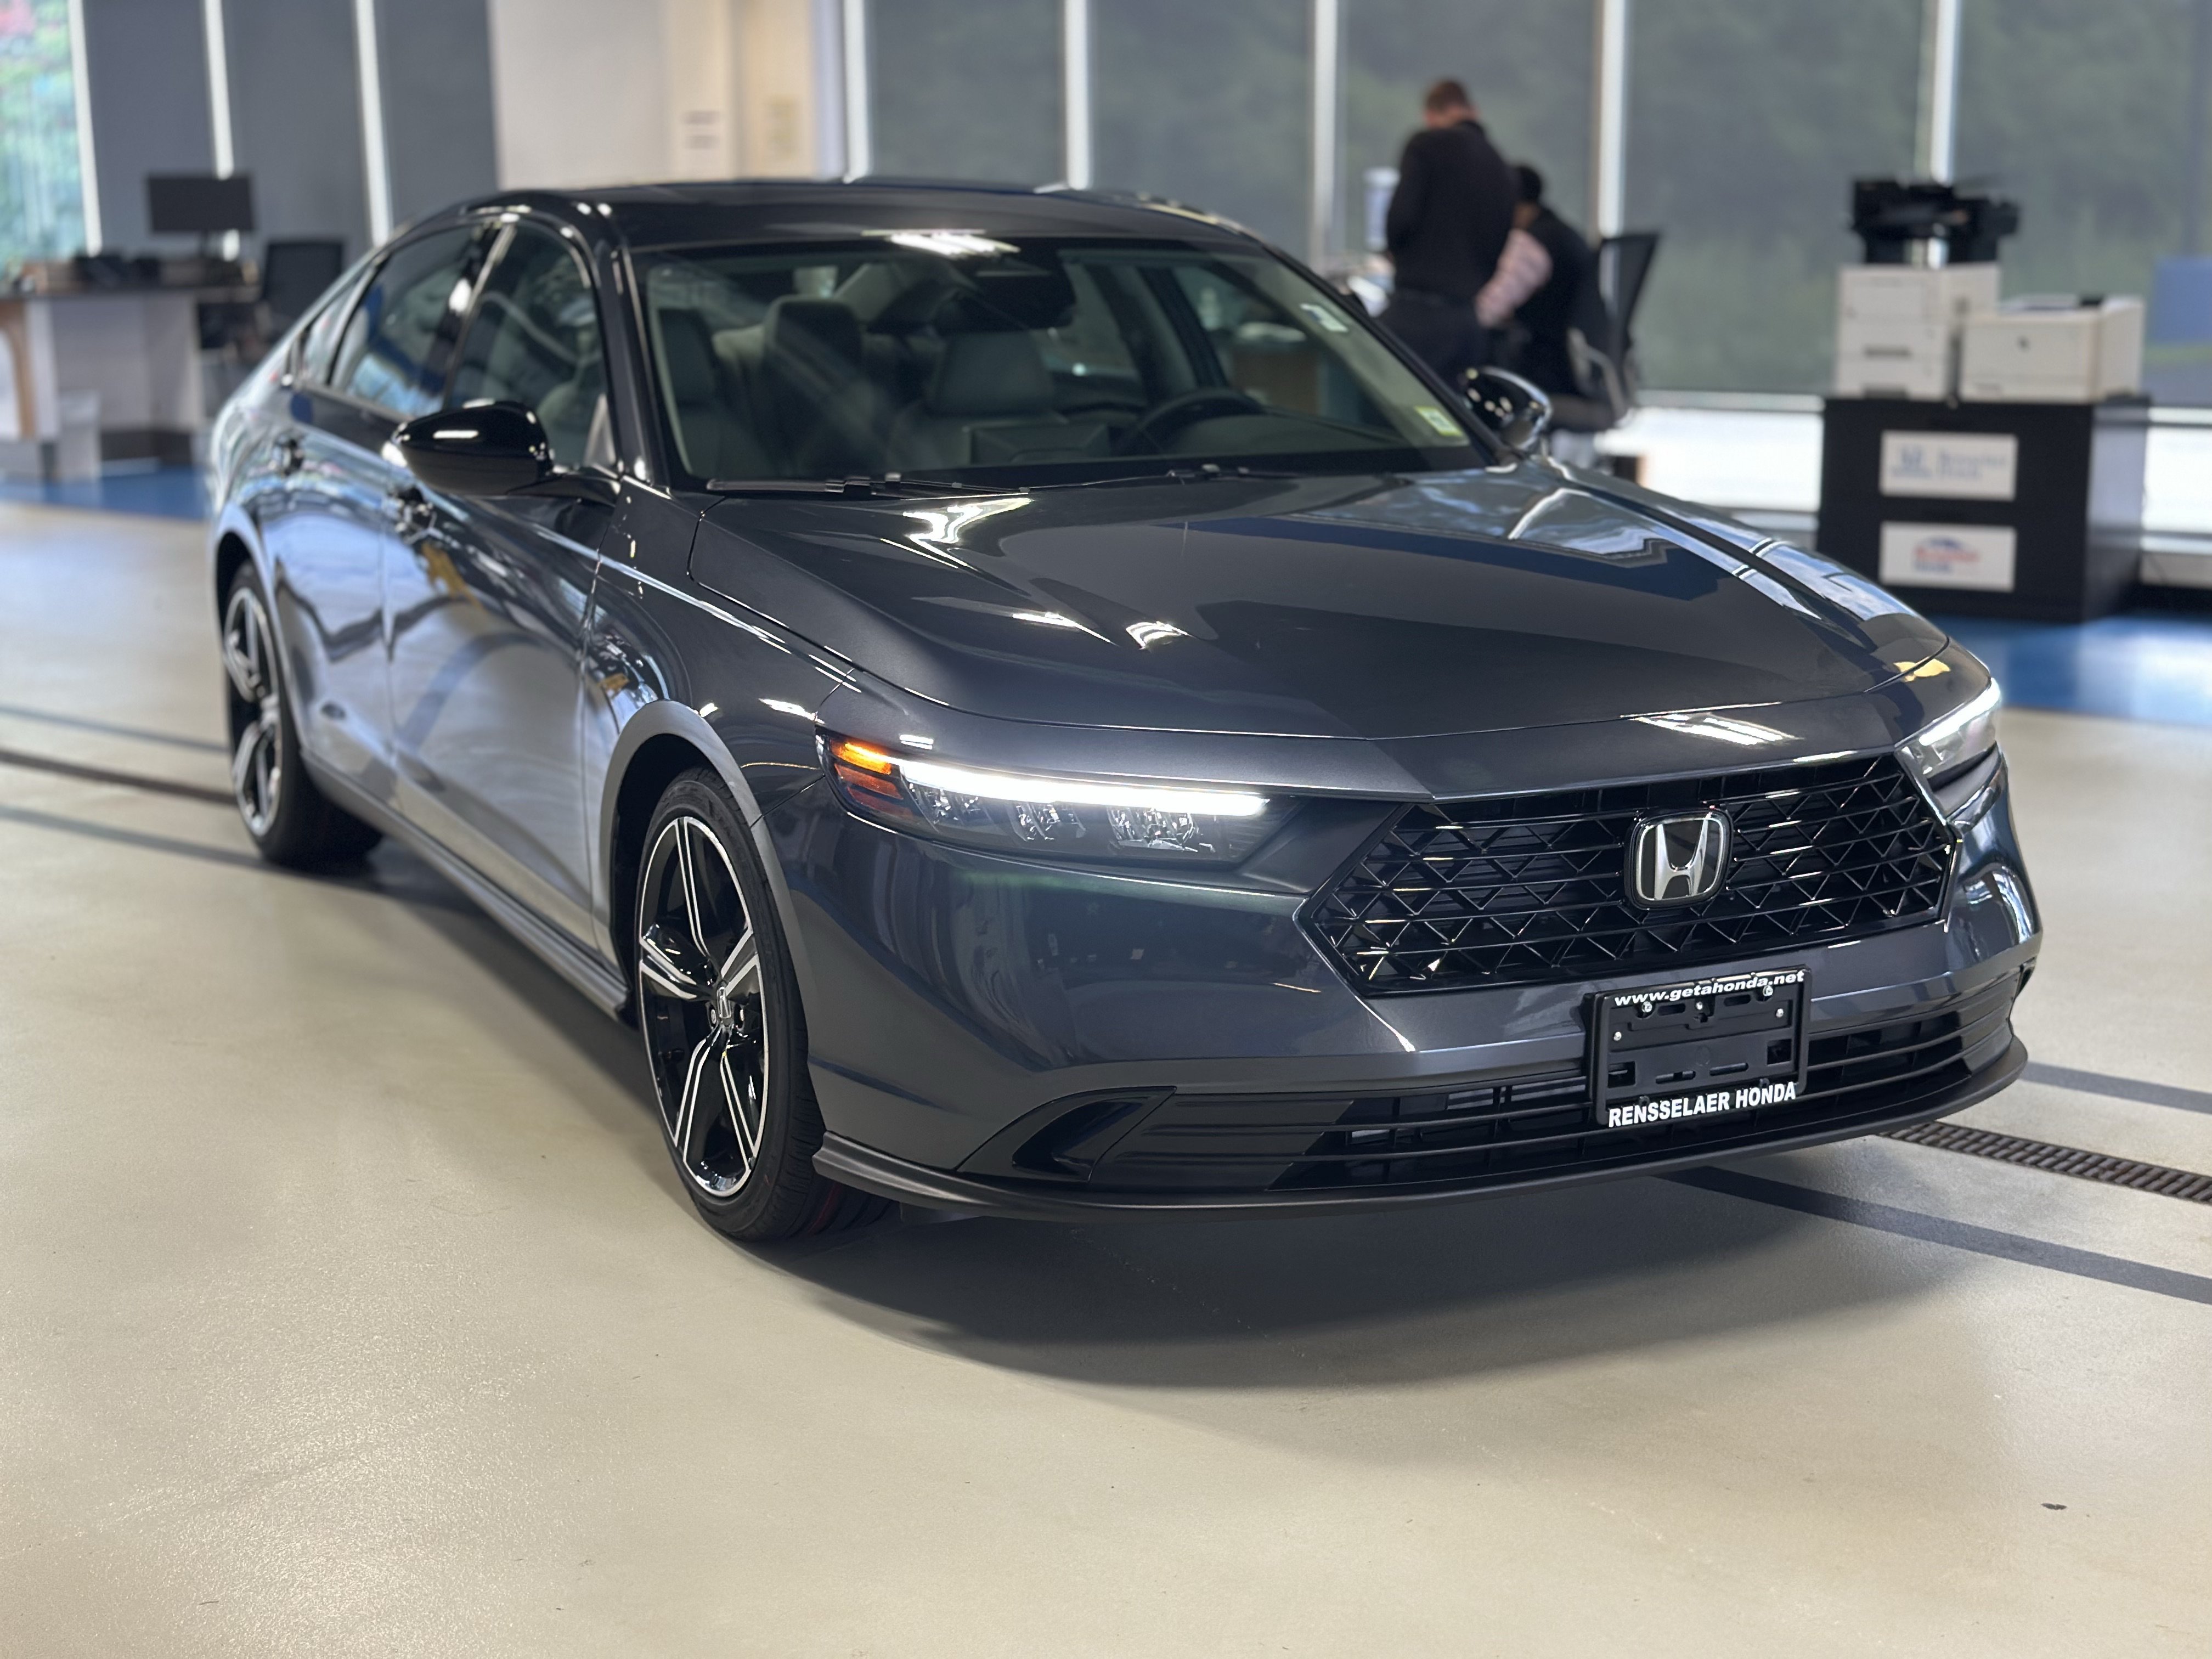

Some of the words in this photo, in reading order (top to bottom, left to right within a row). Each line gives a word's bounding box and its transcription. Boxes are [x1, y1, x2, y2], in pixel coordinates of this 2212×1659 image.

[1615, 970, 1804, 1007] www.getahonda.net
[1609, 1092, 1730, 1127] RENSSELAER
[1735, 1081, 1796, 1108] HONDA
